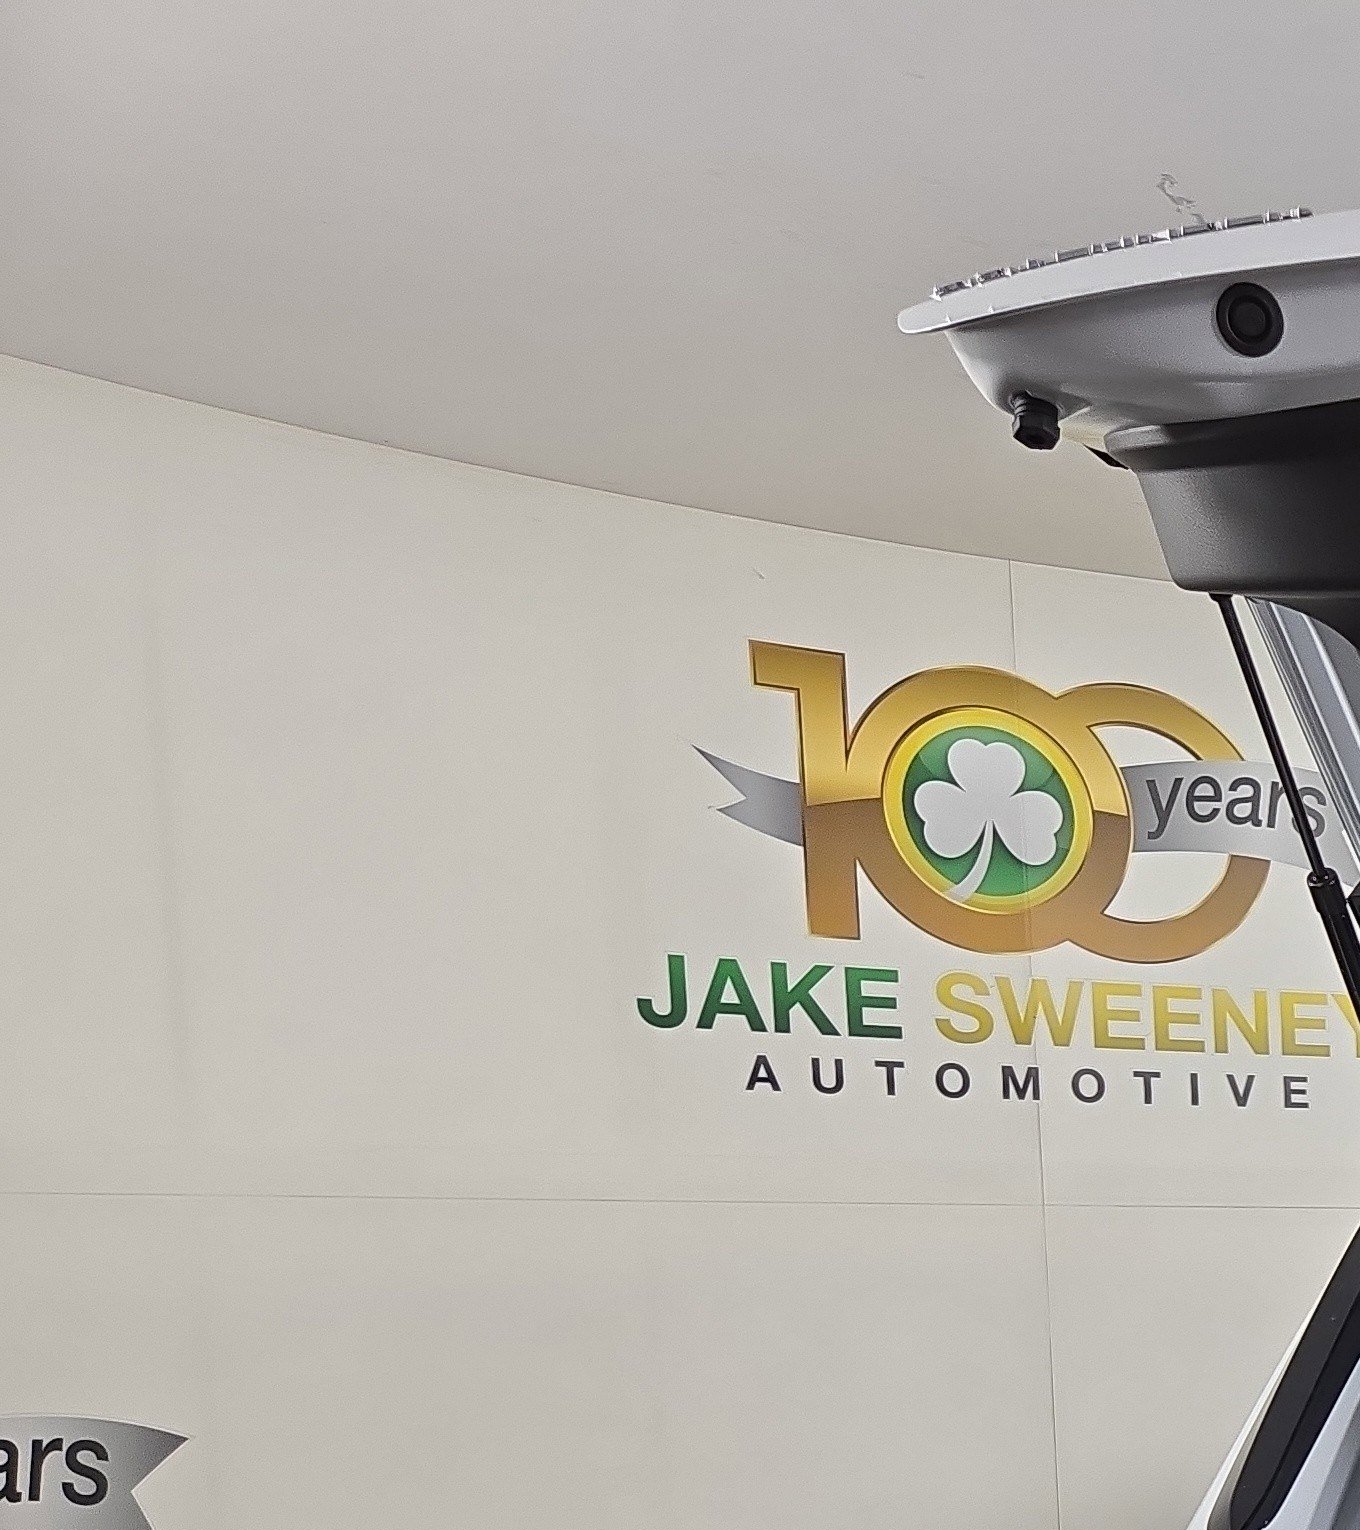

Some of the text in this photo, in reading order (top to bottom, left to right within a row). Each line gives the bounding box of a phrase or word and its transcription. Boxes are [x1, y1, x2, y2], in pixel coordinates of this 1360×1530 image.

[748, 638, 1327, 965] 100 years
[637, 953, 903, 1039] JAKE
[745, 1054, 1310, 1109] AUTOMOTIVE
